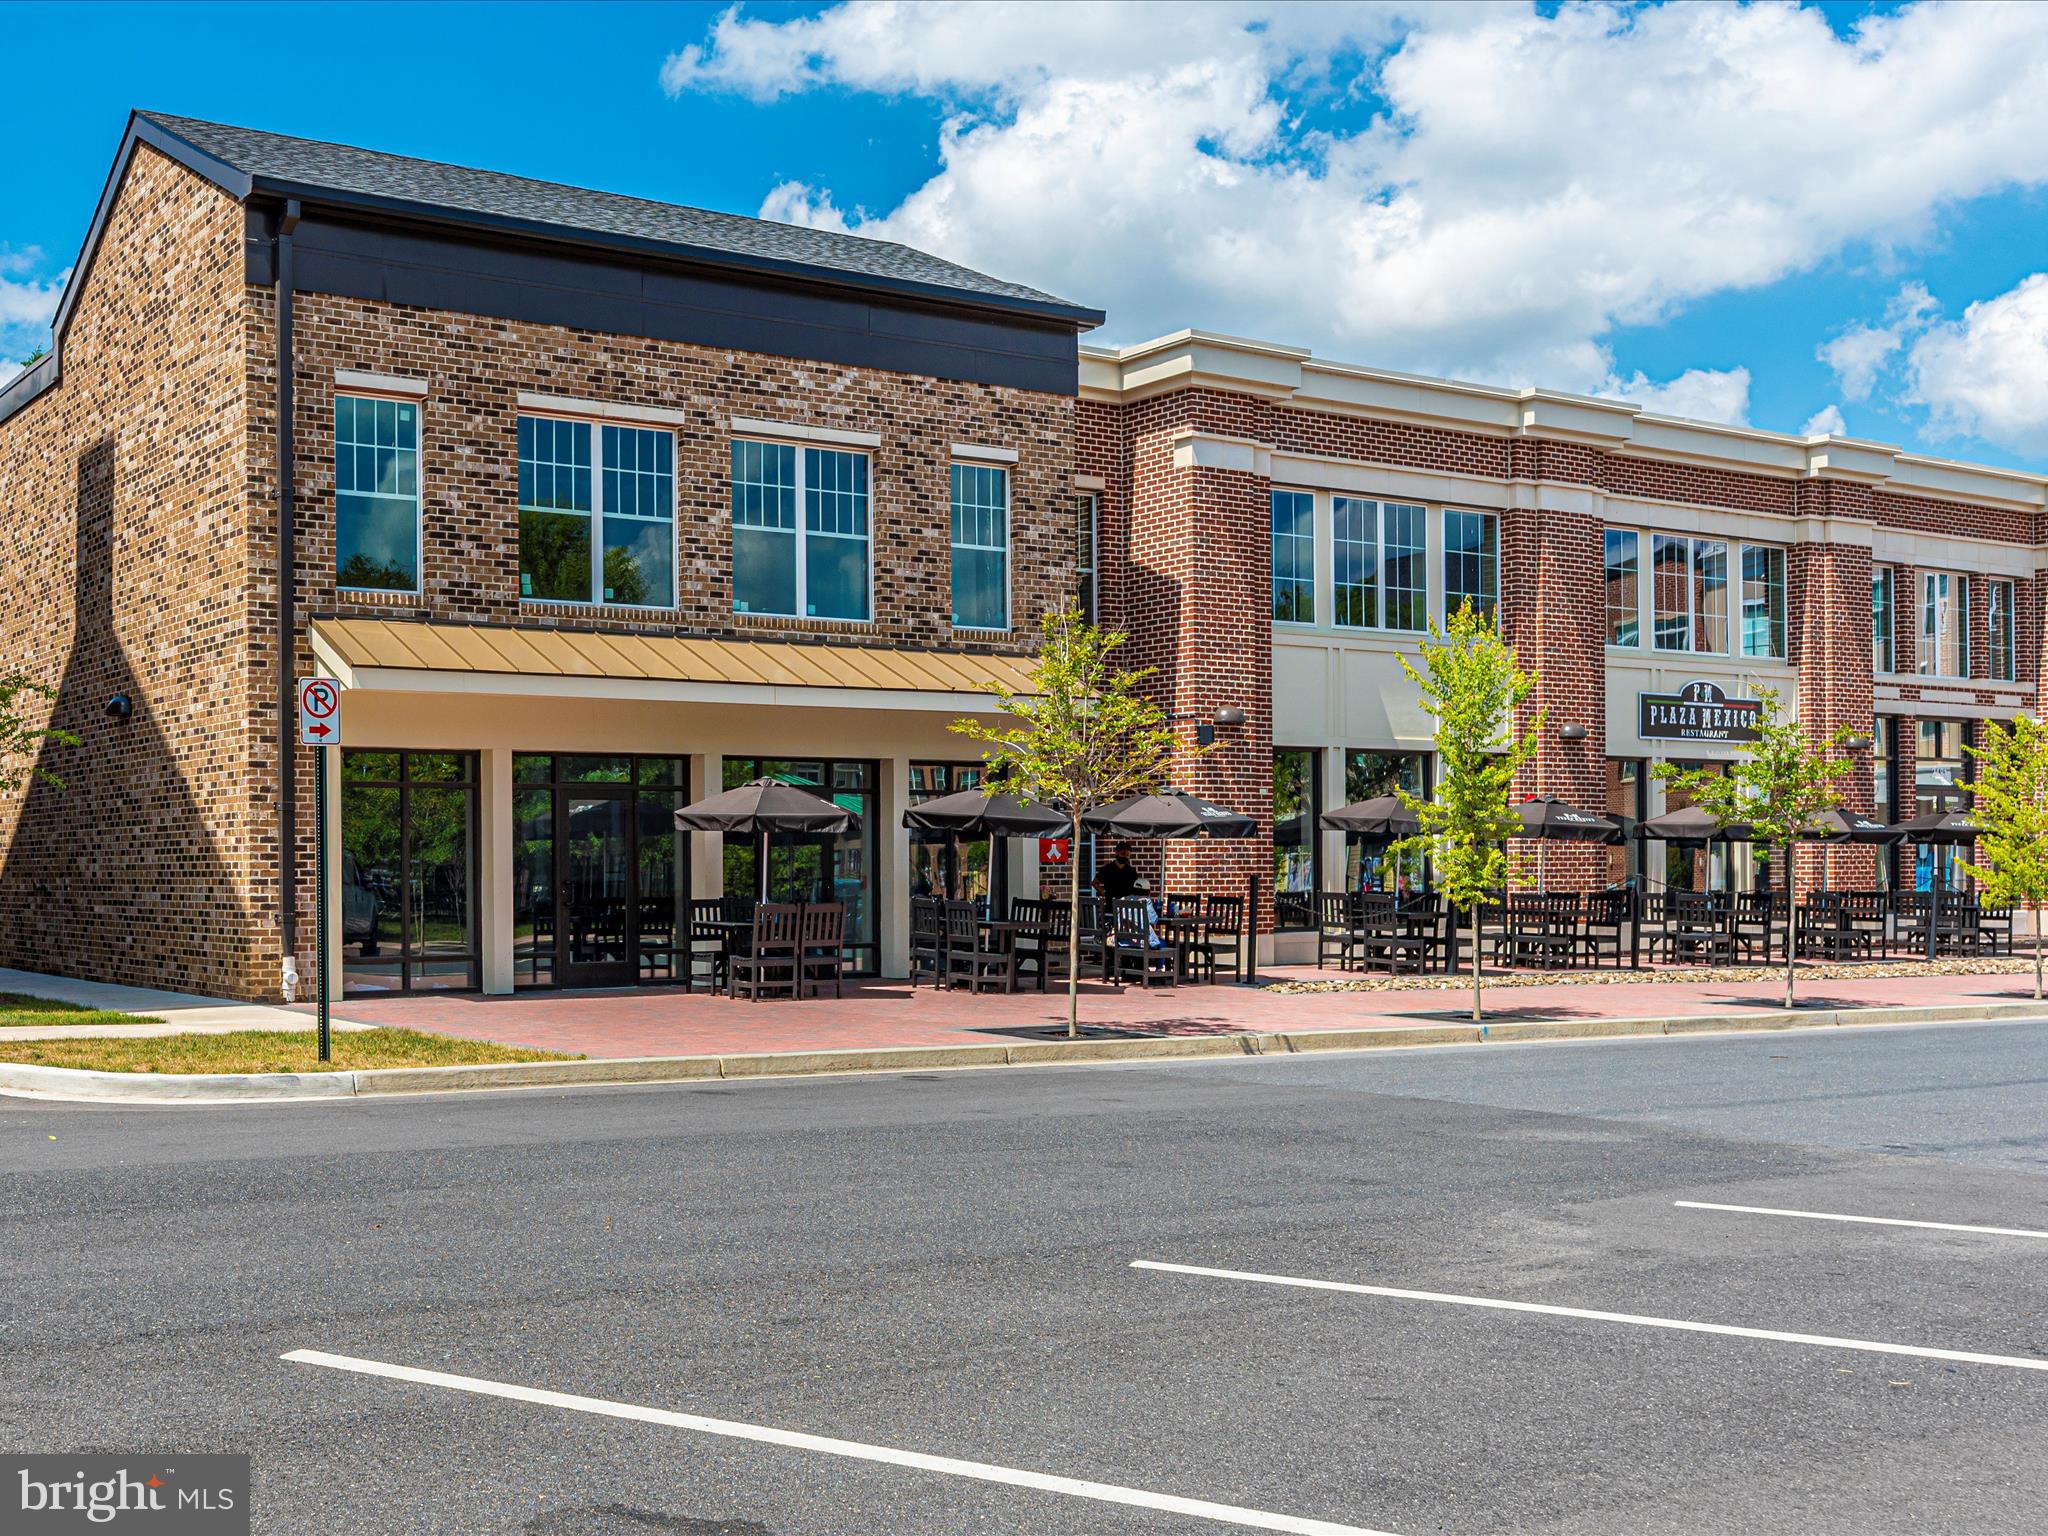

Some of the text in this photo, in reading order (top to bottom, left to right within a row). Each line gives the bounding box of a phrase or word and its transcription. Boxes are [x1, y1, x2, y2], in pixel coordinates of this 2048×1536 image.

[1650, 705, 1757, 729] PLAZA MEXICO
[1680, 728, 1729, 739] RESTAURANT
